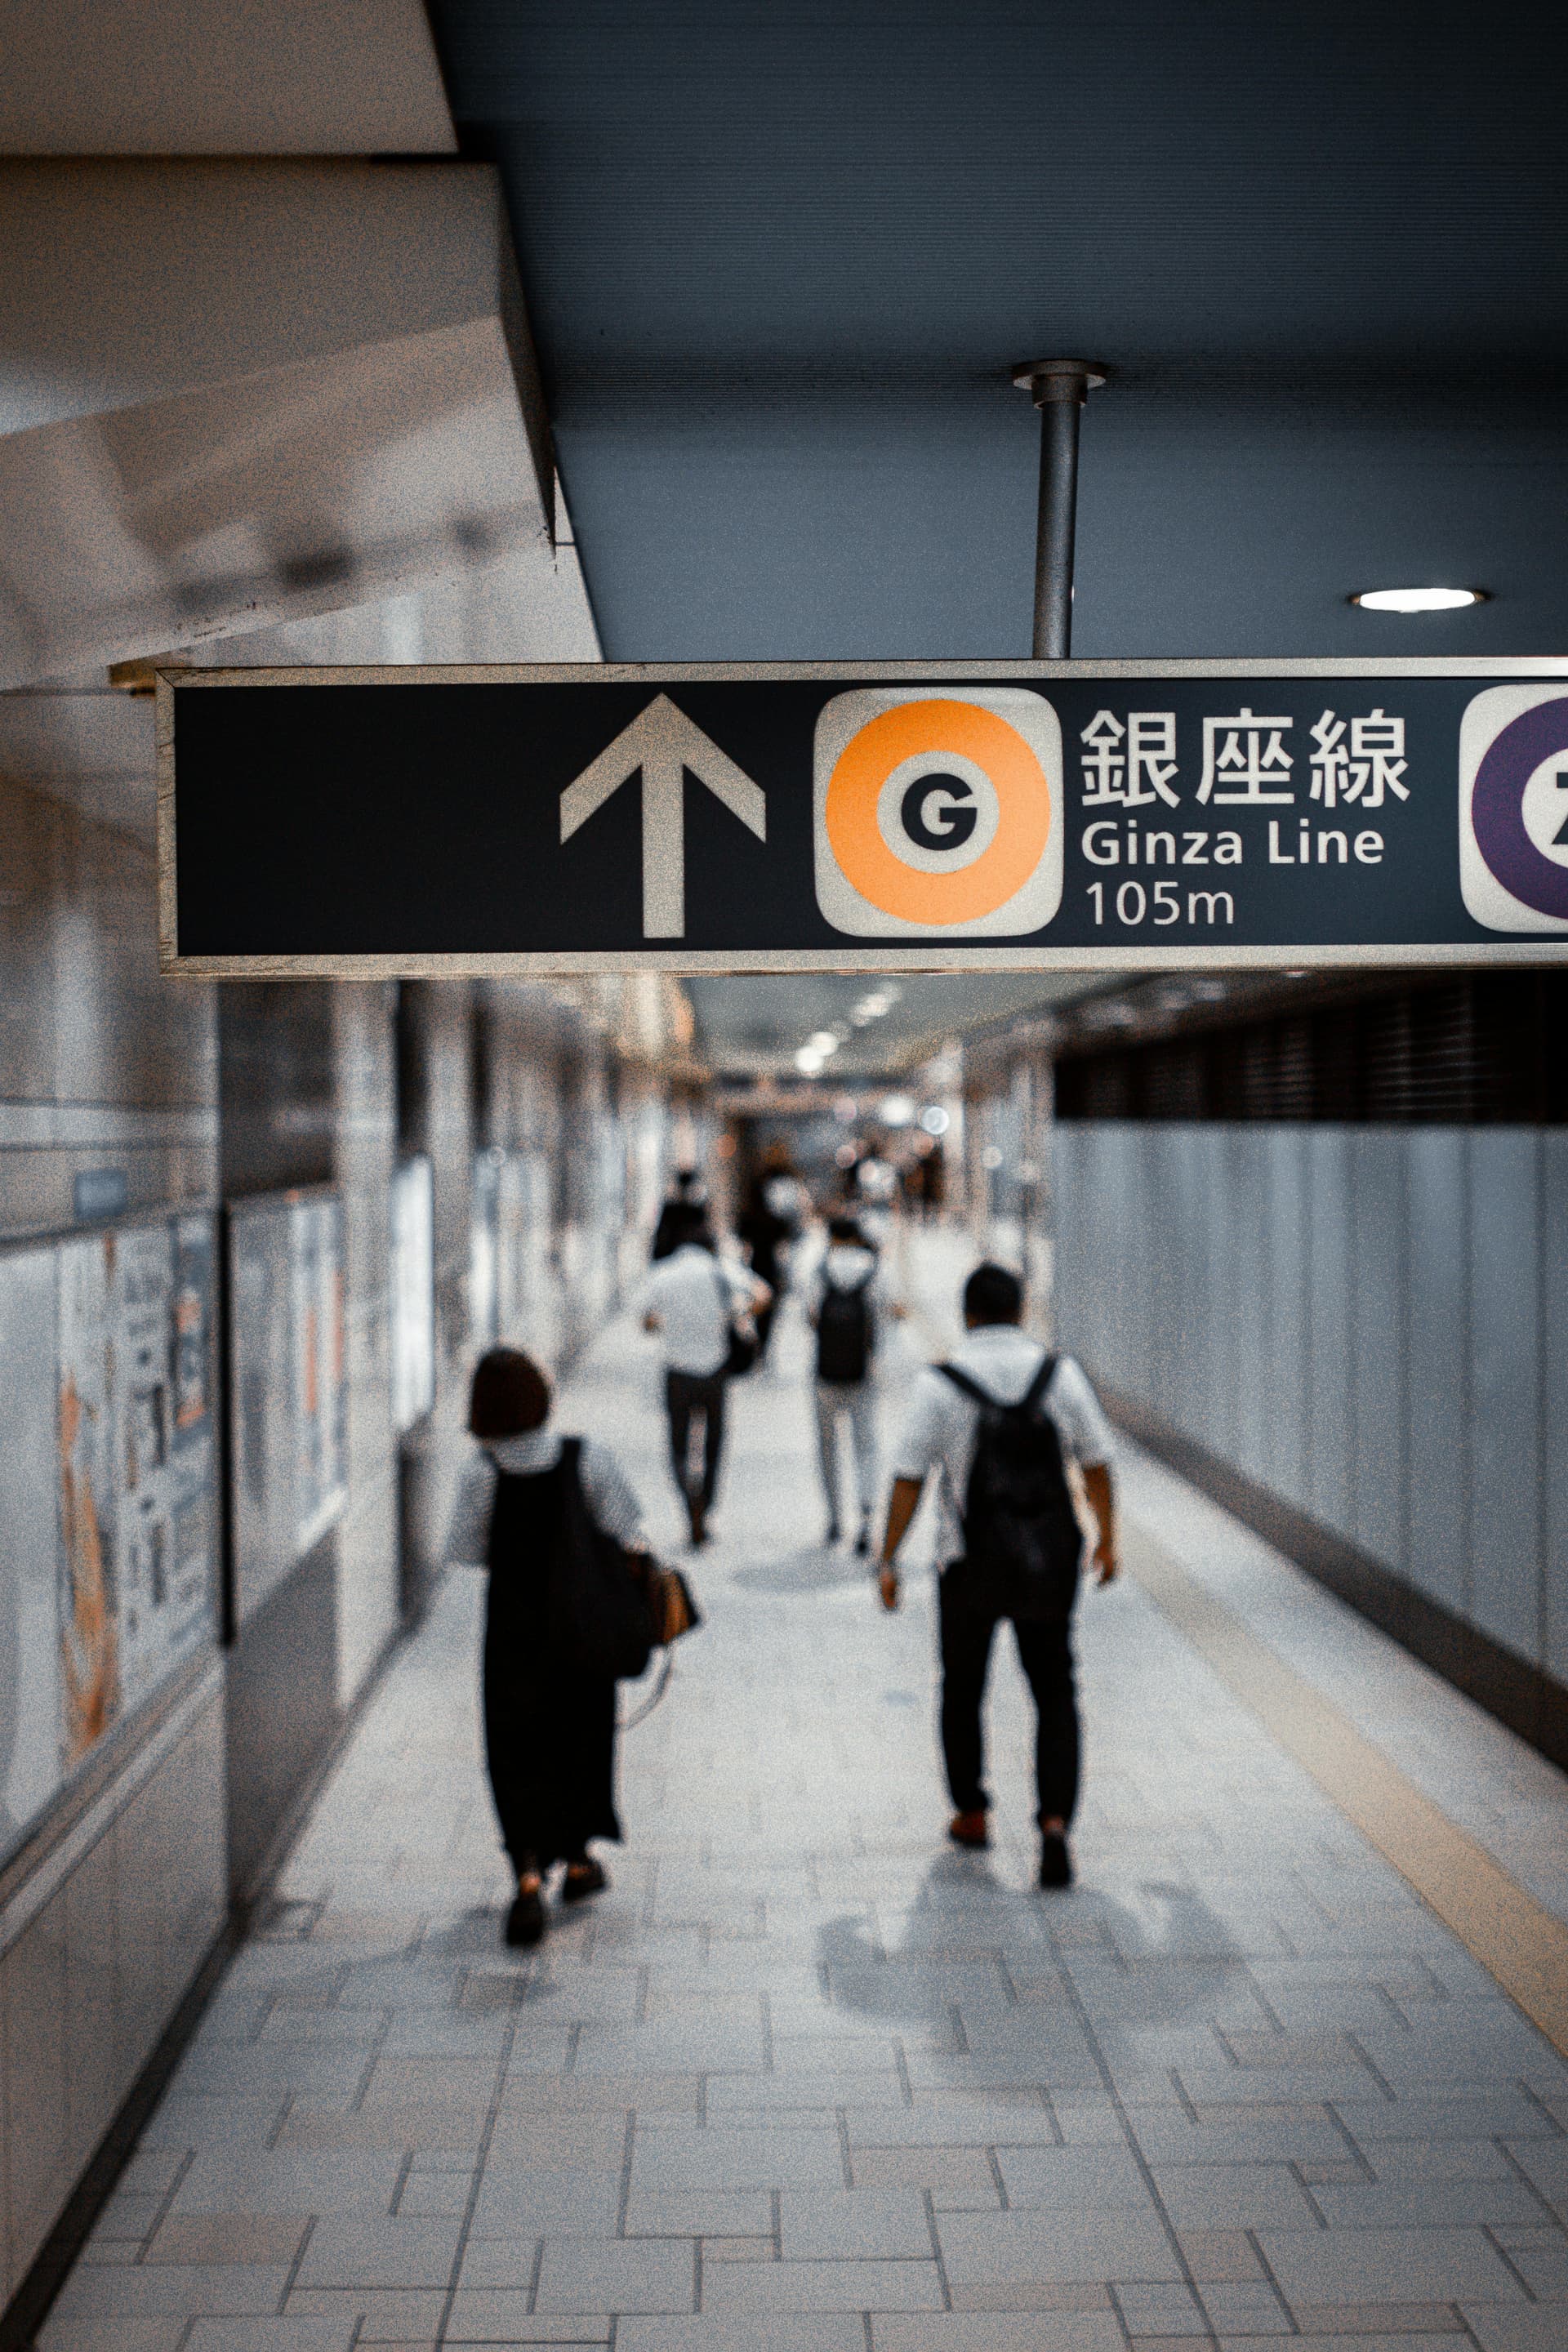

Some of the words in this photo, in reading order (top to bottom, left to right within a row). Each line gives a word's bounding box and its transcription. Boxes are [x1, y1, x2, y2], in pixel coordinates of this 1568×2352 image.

[1080, 707, 1411, 808] 銀座線
[900, 773, 978, 852] G
[1080, 819, 1243, 866] Ginza
[1267, 817, 1385, 865] Line
[1086, 880, 1235, 925] 105m
